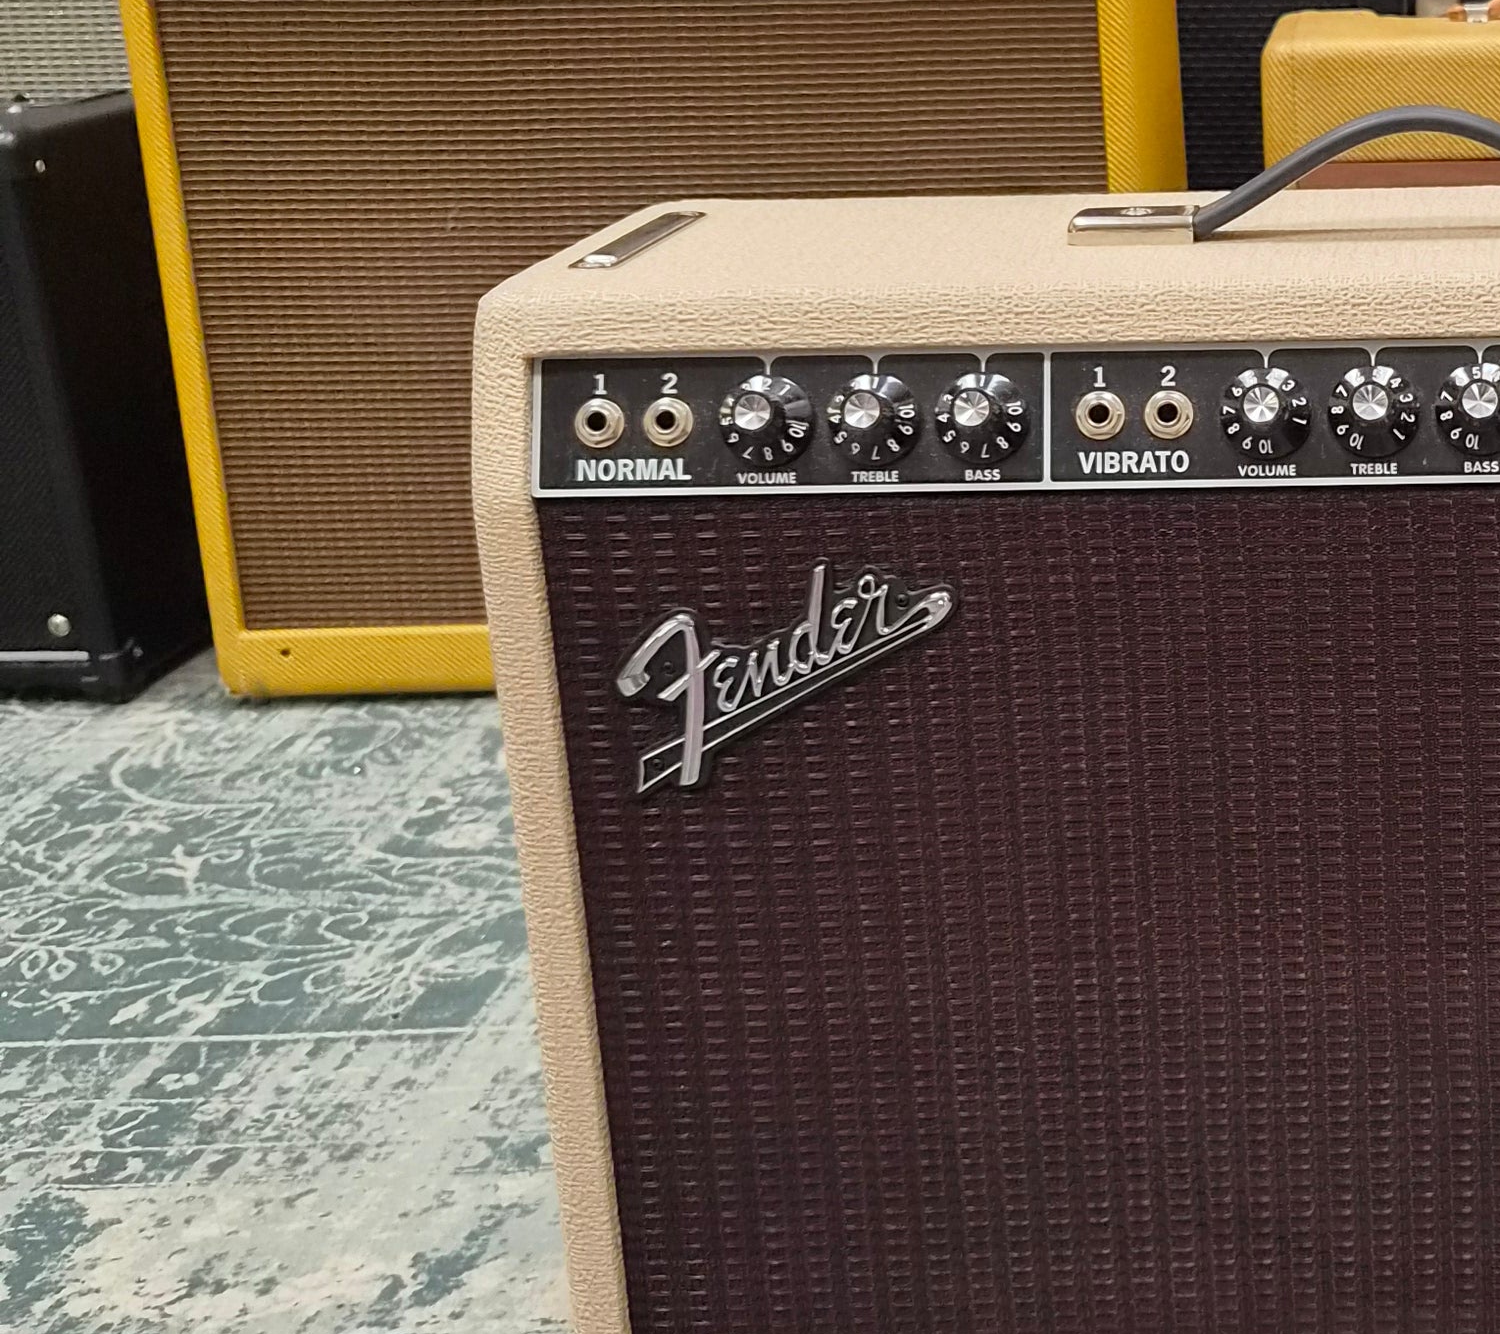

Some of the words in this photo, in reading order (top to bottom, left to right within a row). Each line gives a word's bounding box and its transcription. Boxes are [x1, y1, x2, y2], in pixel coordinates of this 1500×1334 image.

[1092, 366, 1107, 388] 1
[1160, 365, 1177, 387] 2
[1472, 366, 1481, 380] 5
[592, 373, 608, 395] 1
[660, 372, 679, 394] 2
[1281, 379, 1296, 392] 3
[1335, 384, 1348, 397] 7
[1440, 390, 1454, 403] 7
[1291, 396, 1307, 408] 2
[1399, 393, 1414, 403] 3
[1222, 405, 1236, 415] 7
[1330, 406, 1344, 415] 8
[1439, 410, 1453, 421] 8
[1400, 411, 1416, 423] 2
[980, 443, 991, 458] 7
[996, 436, 1009, 449] 8
[1005, 400, 1023, 416] 10
[1227, 422, 1240, 435] 8
[871, 445, 881, 460] 7
[886, 438, 900, 452] 8
[1077, 450, 1190, 474] VIBRATO
[1463, 461, 1500, 473] BASS
[576, 457, 692, 482] NORMAL
[964, 468, 1001, 481] BASS
[1237, 464, 1297, 477] VOLUME
[1350, 463, 1398, 475] TREBLE
[736, 471, 797, 484] VOLUME
[851, 470, 899, 483] TREBLE
[617, 565, 952, 793] Fender
